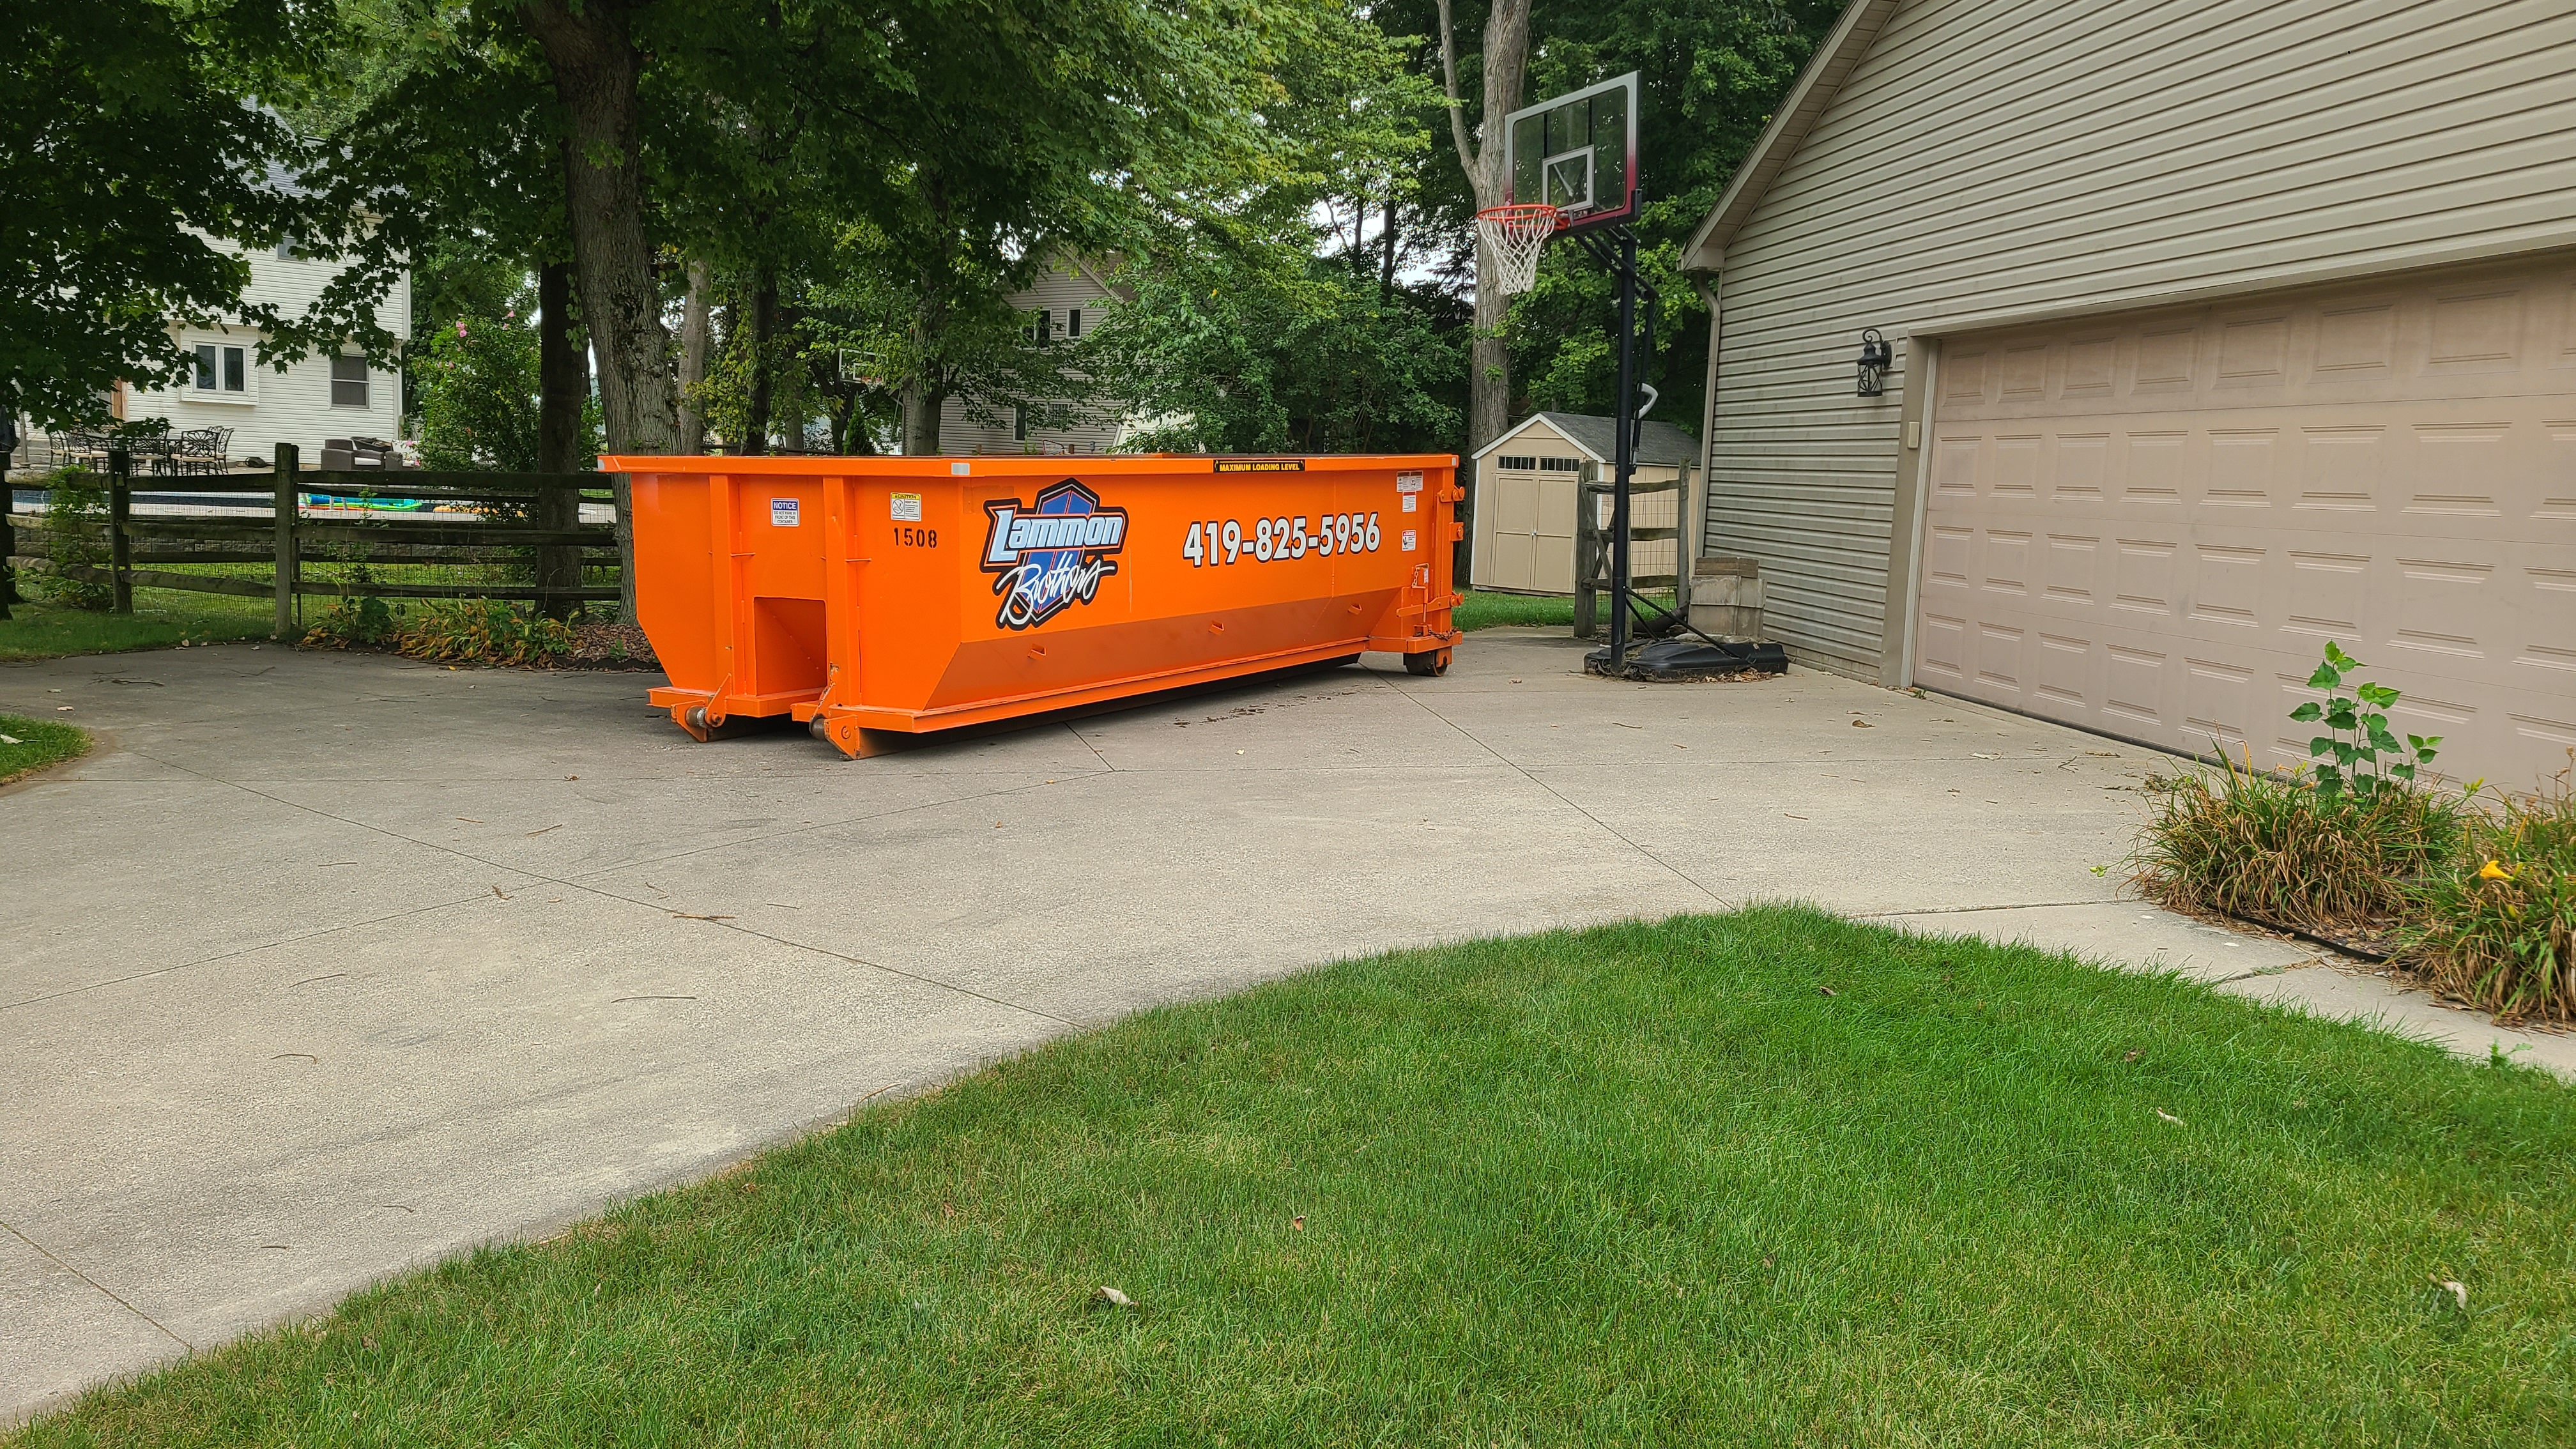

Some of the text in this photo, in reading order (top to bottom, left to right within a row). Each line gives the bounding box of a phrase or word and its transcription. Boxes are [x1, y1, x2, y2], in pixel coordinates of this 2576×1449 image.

[773, 502, 797, 510] NOTICE
[894, 528, 937, 548] 1508
[988, 509, 1124, 562] Lammon
[1183, 512, 1381, 567] 419-825-5956
[996, 551, 1116, 625] Brothers
